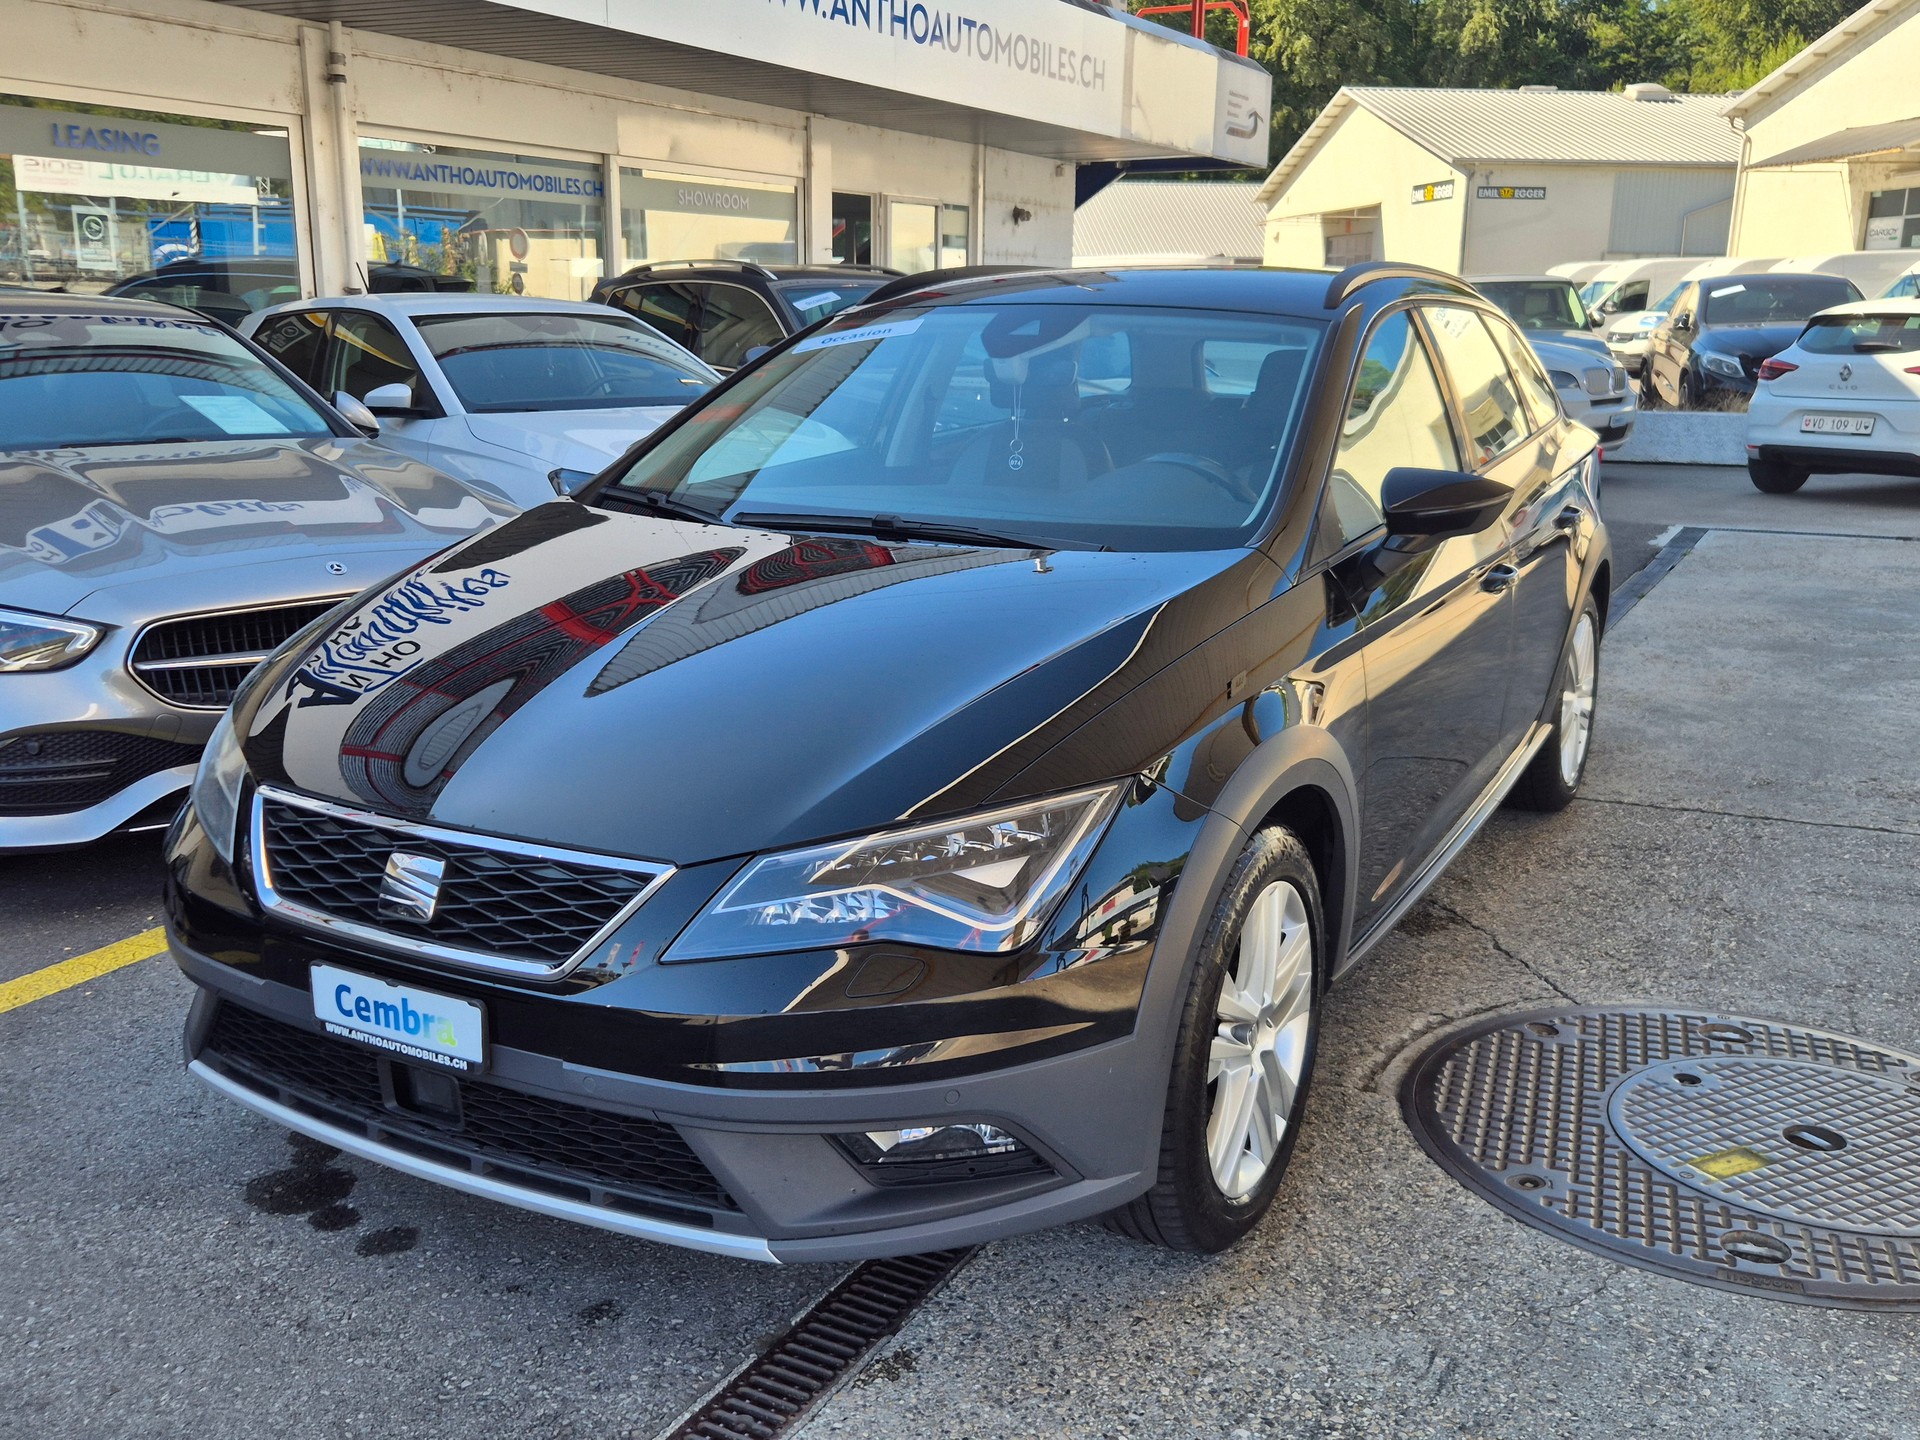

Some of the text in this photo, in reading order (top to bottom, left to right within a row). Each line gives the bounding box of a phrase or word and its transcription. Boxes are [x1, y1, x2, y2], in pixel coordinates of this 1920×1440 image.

[51, 122, 161, 157] LEASING
[360, 157, 605, 199] WWW.ANTHOAUTOMOBILES.CH
[677, 188, 750, 211] SHOWROOM
[1433, 184, 1453, 200] EGGER
[1478, 188, 1545, 199] EMIL EGGER
[821, 327, 893, 345] Occasion
[1812, 418, 1825, 430] VD
[1831, 419, 1850, 431] 109
[334, 984, 458, 1048] Cembra
[325, 1022, 468, 1071] WWW.ANTHOAUTOMOBILES.CH
